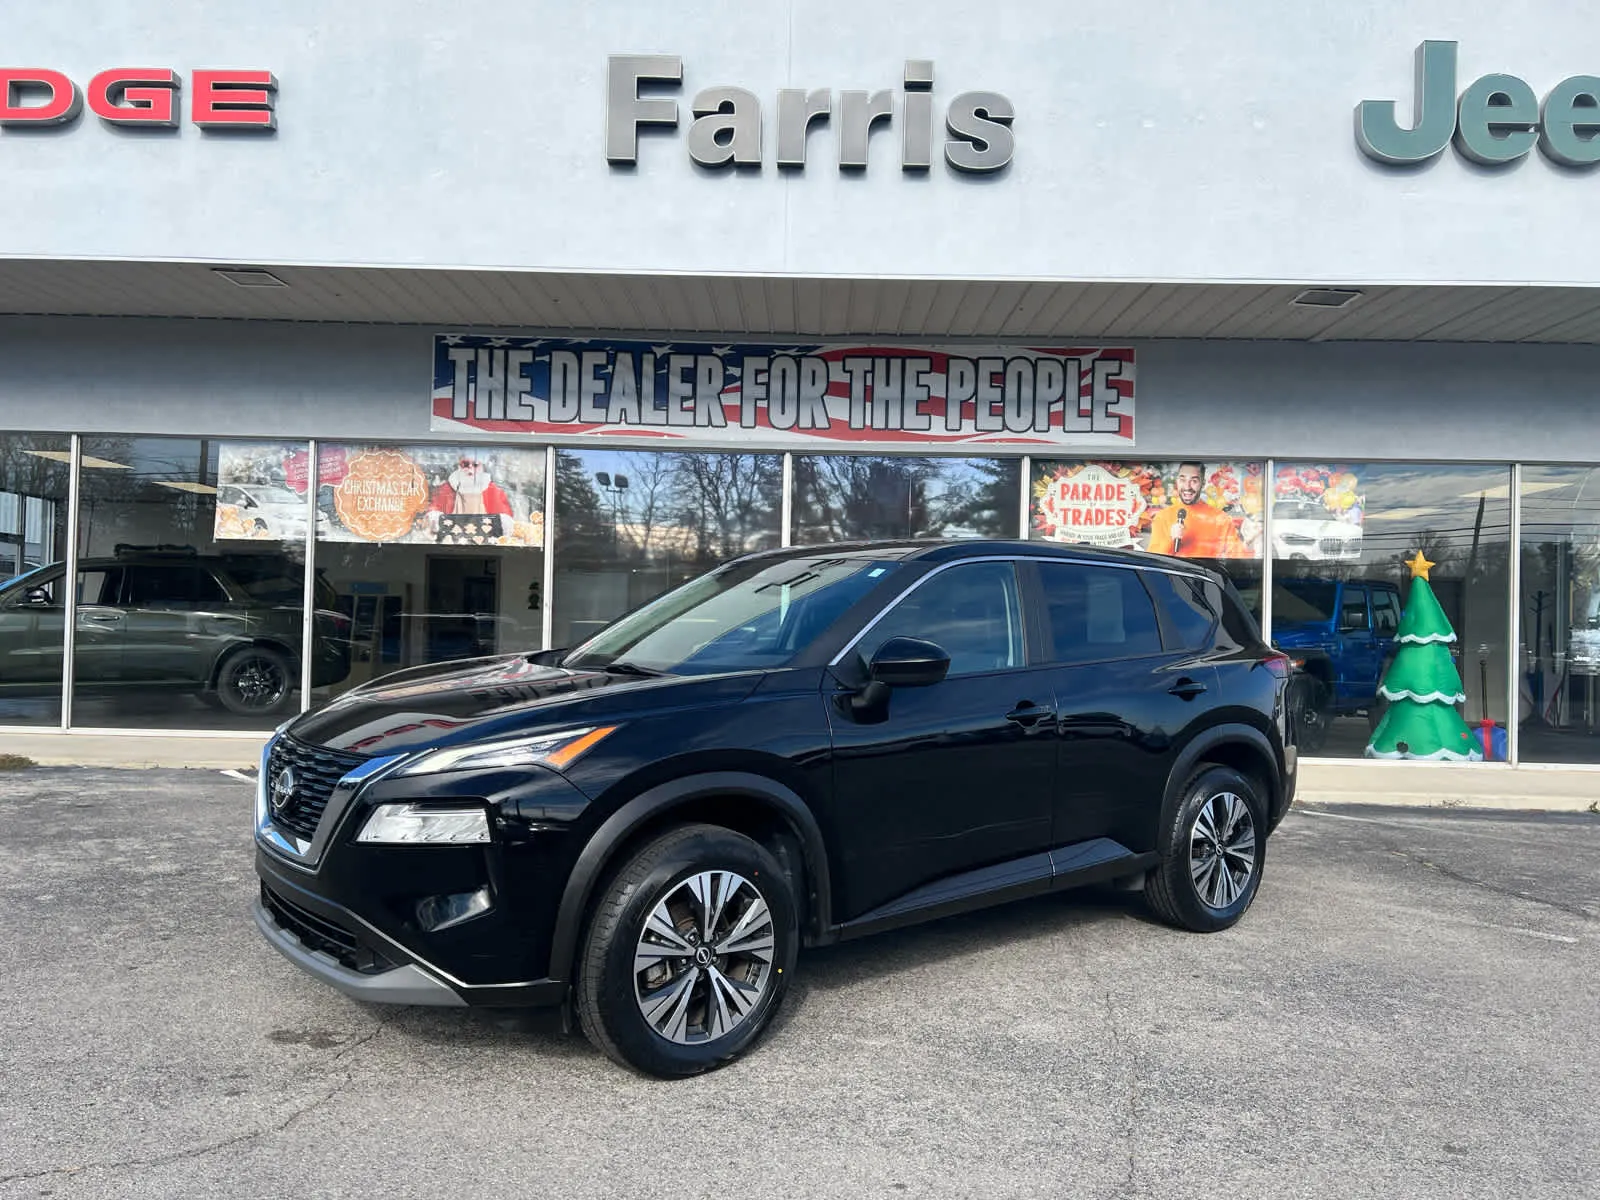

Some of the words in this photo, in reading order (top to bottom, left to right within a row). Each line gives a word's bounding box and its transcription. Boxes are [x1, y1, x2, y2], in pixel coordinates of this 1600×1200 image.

[606, 54, 1016, 171] Farris
[1355, 40, 1600, 164] Jee
[448, 347, 534, 422] THE
[548, 350, 727, 428] DEALER
[740, 353, 831, 431] FOR
[843, 356, 932, 432] THE
[945, 356, 1122, 433] PEOPLE
[344, 480, 399, 496] CHRISTMAS
[400, 481, 420, 497] CAR
[1060, 483, 1127, 501] PARADE
[1059, 508, 1127, 527] TRADES
